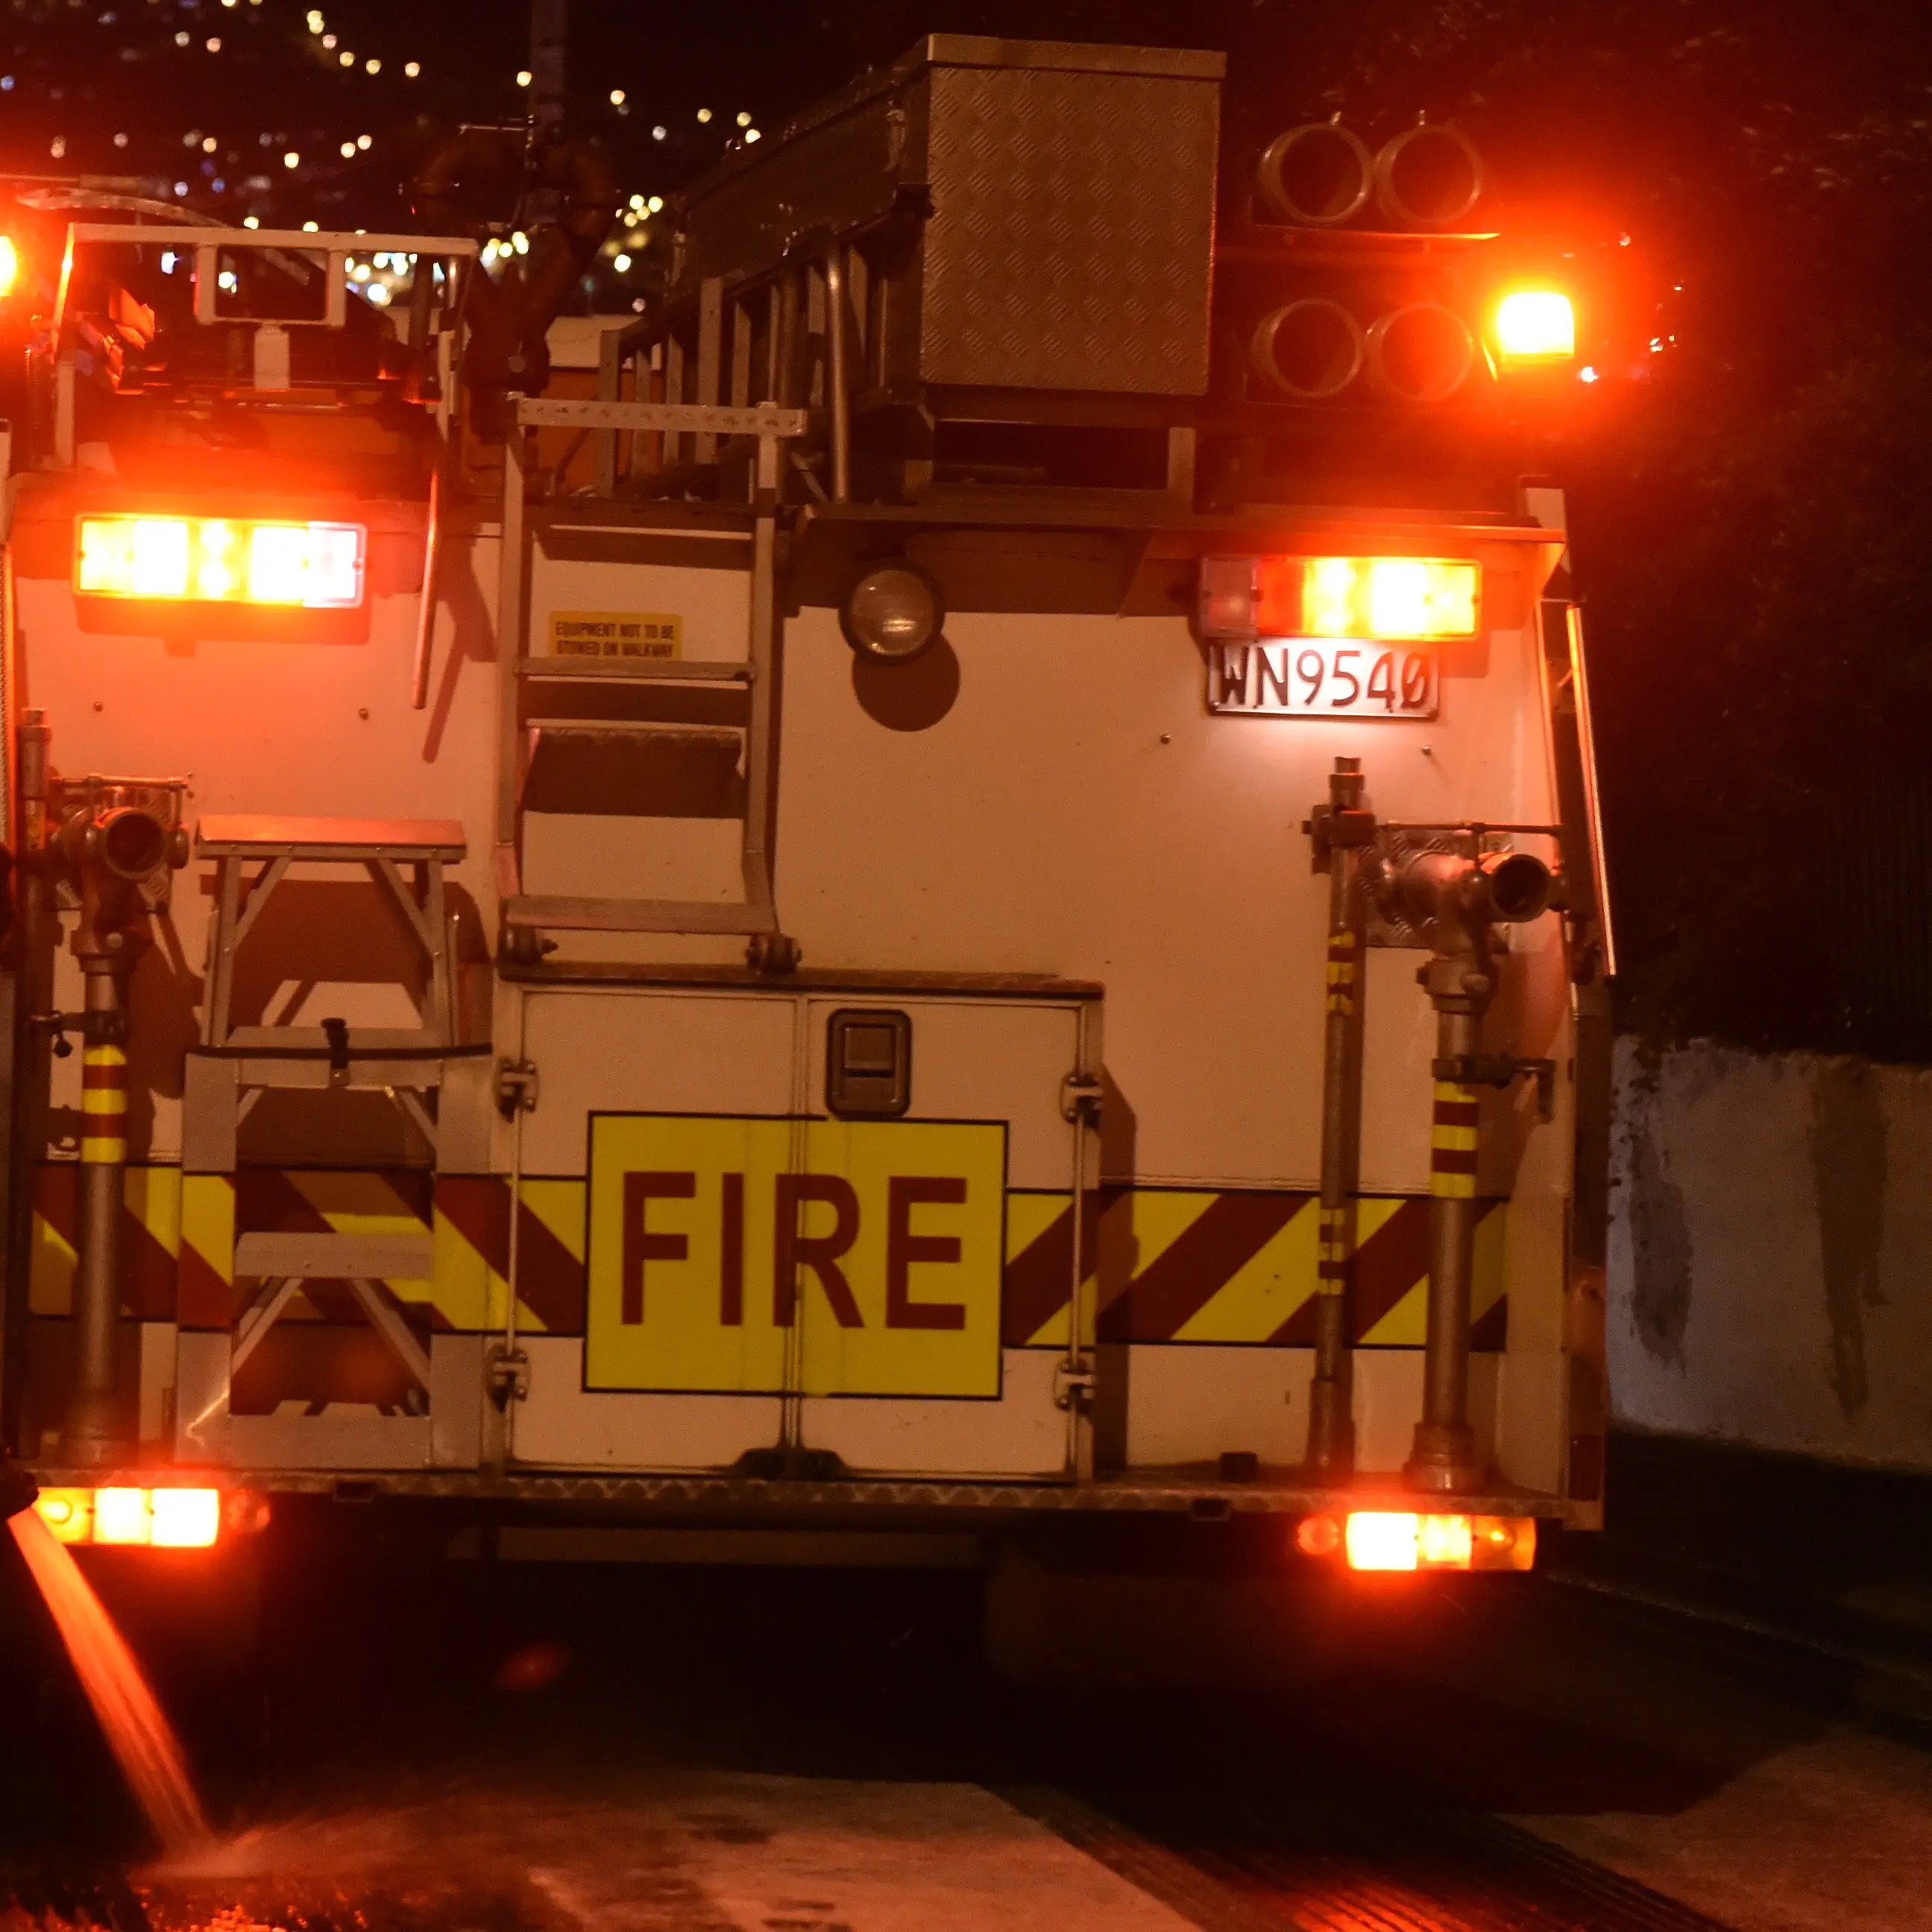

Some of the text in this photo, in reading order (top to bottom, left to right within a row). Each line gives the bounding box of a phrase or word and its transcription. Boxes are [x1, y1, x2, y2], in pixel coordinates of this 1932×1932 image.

[556, 621, 674, 640] EQUIPMENT NOT TO BE
[1215, 647, 1429, 711] WN9540
[621, 1171, 968, 1330] FIRE
